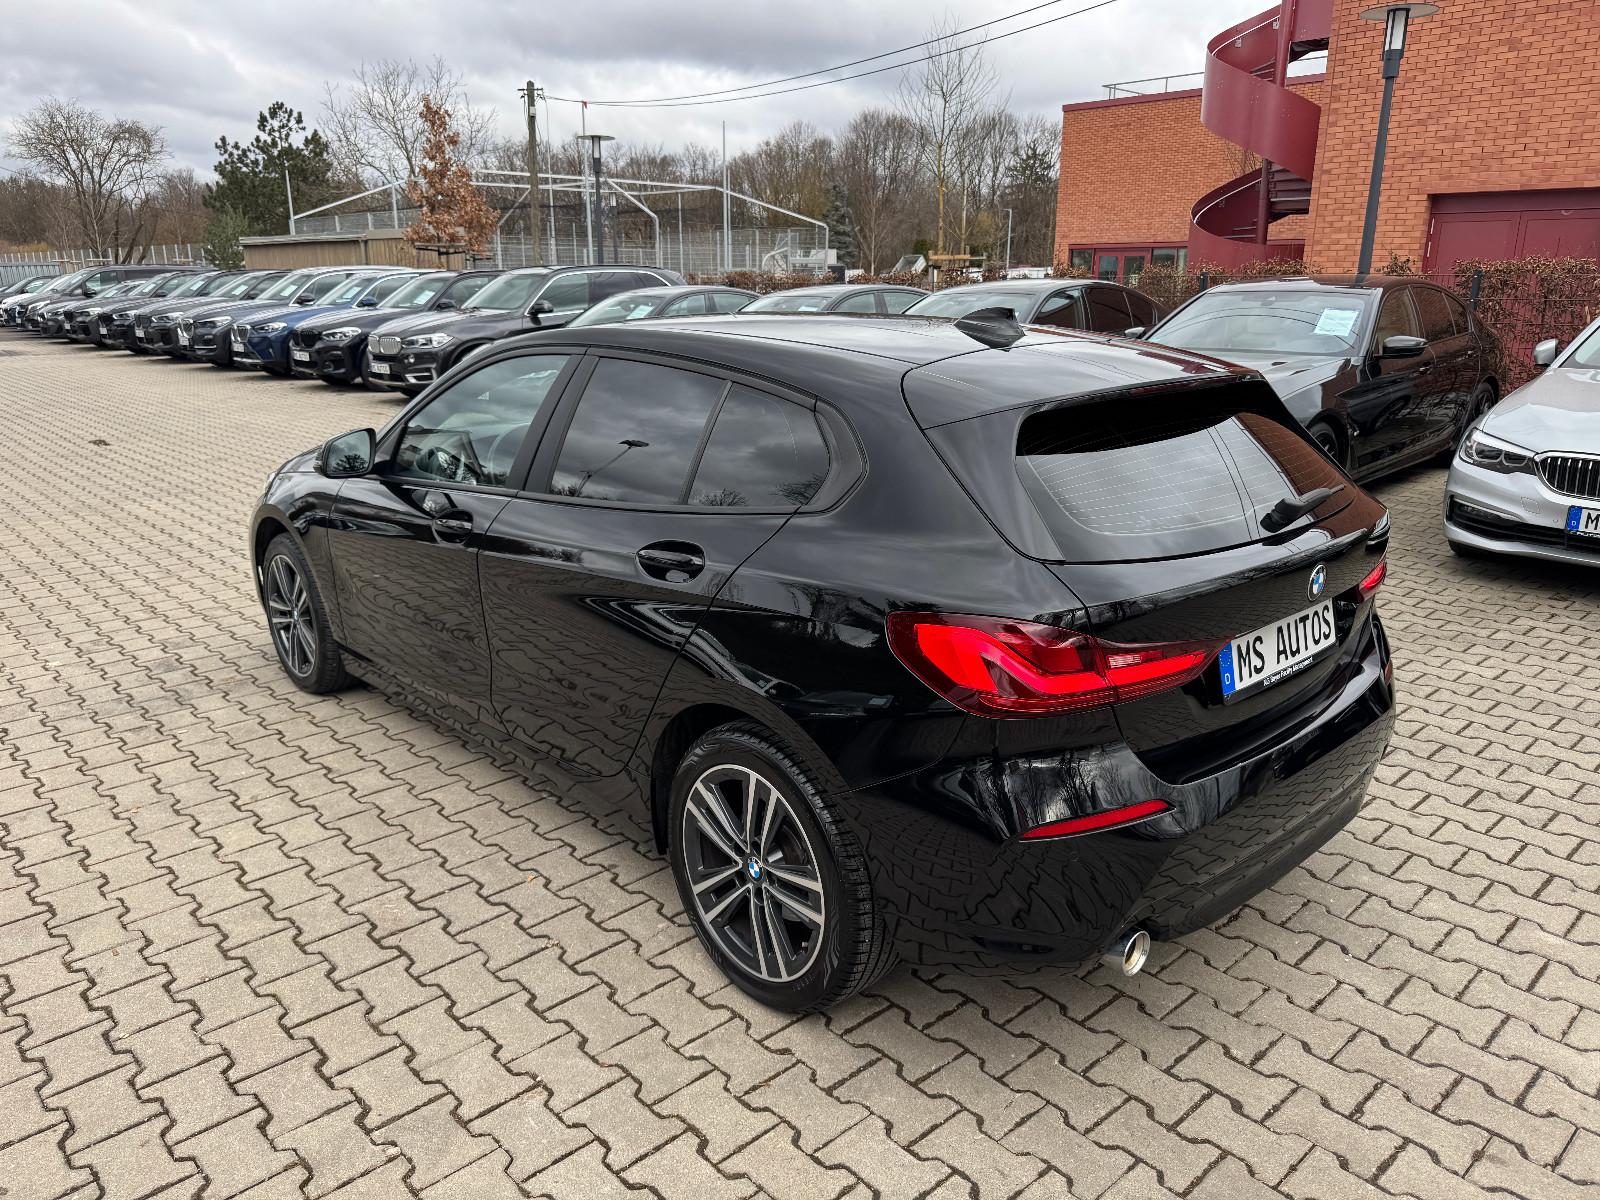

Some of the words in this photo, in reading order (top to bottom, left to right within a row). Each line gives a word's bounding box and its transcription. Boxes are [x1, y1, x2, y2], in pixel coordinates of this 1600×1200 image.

[1236, 635, 1266, 683] MS
[1276, 604, 1332, 665] AUTOS
[1224, 673, 1231, 685] D
